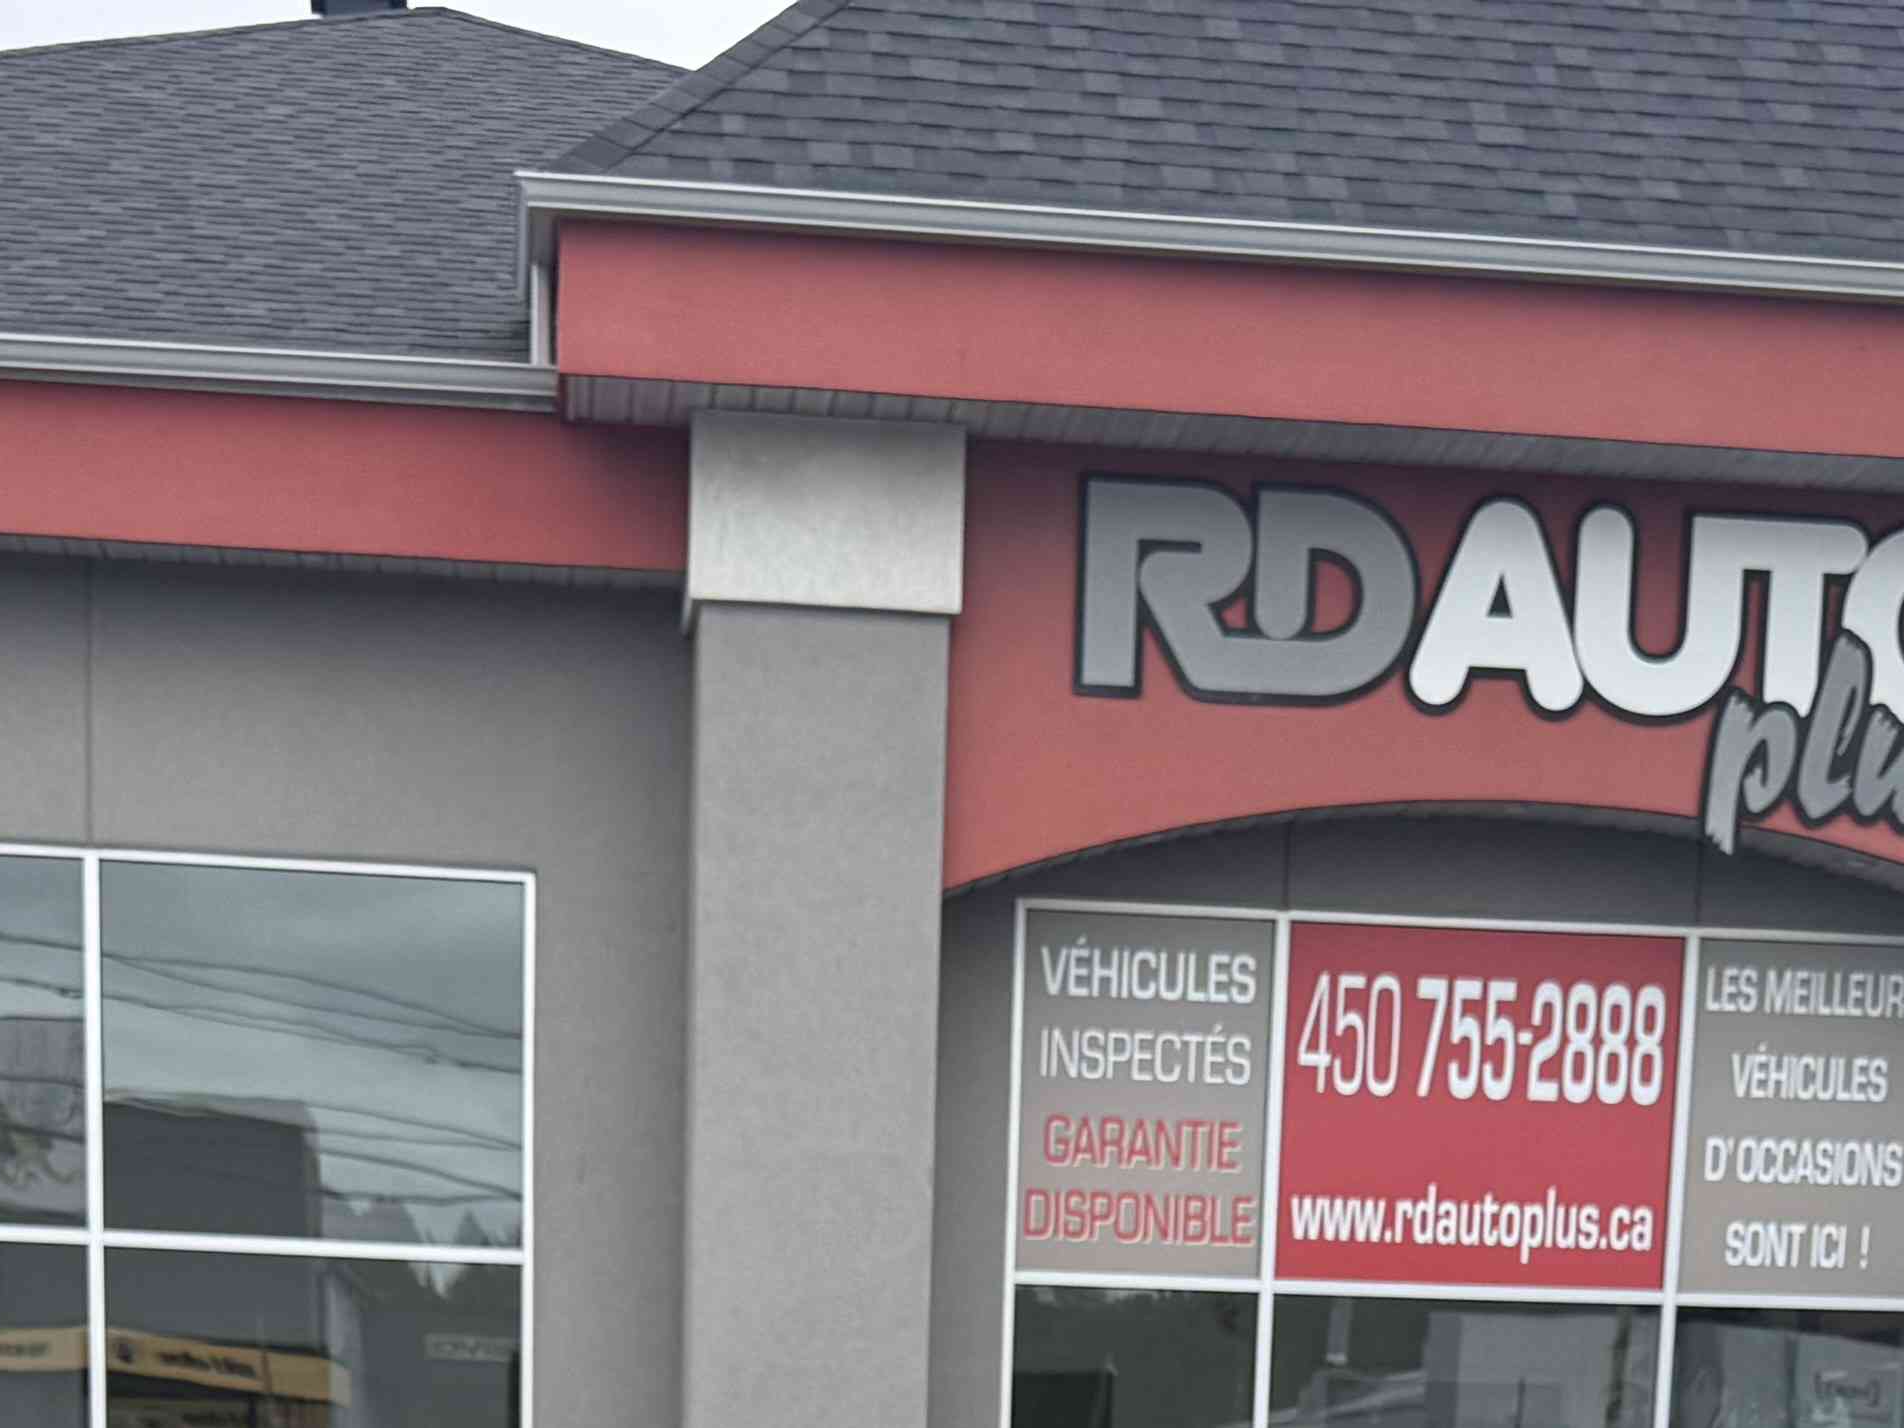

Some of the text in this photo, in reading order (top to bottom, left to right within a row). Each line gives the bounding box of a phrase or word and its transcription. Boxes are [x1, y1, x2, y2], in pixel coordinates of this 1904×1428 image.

[1040, 935, 1258, 1005] VÉHICULES
[1705, 966, 1758, 1015] LES
[1039, 1022, 1253, 1086] INSPECTÉS
[1297, 970, 1667, 1107] 450 755-2888
[1731, 1041, 1889, 1103] VÉHICULES
[1042, 1112, 1244, 1174] GARANTIE
[1022, 1187, 1257, 1248] DISPONIBLE
[1290, 1182, 1654, 1266] www.rdautoplus.ca
[1724, 1220, 1807, 1270] SONT
